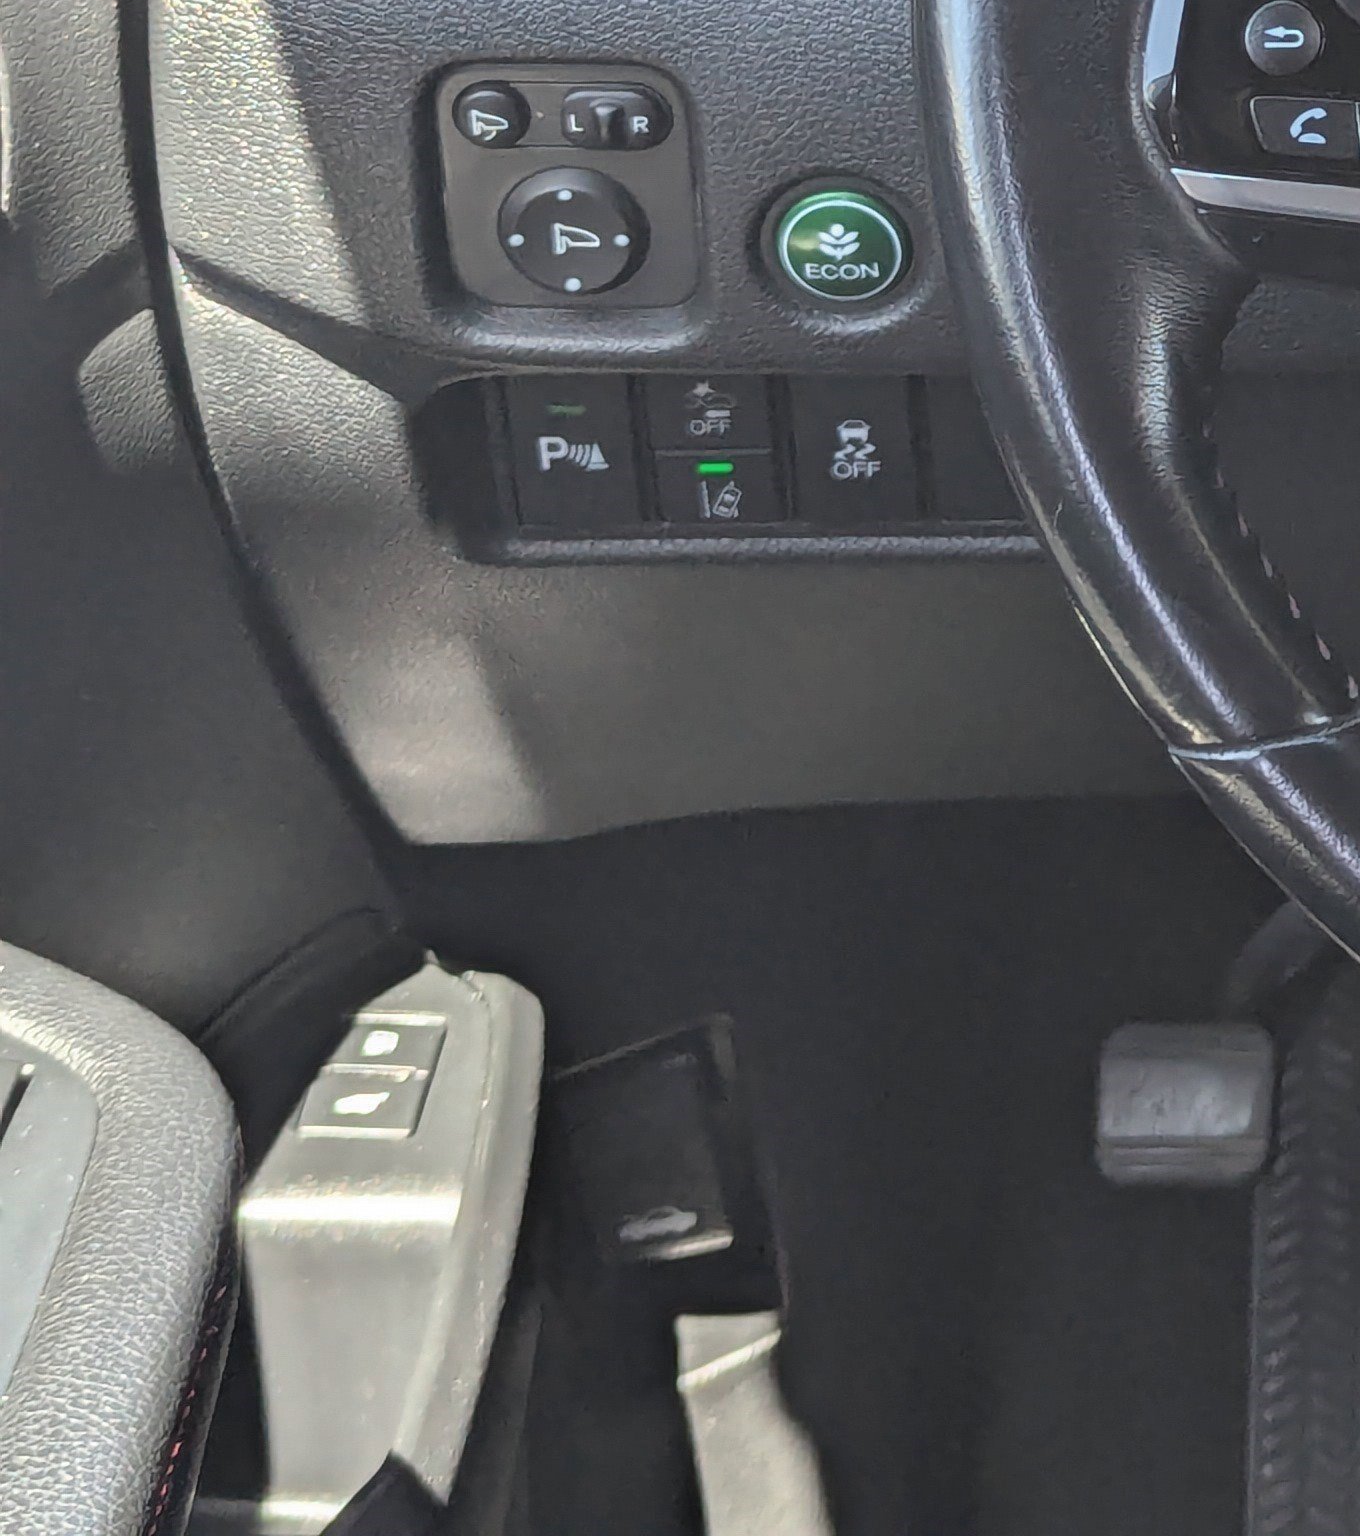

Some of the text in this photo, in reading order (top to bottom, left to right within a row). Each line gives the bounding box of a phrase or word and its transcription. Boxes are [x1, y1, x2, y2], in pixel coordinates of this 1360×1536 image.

[569, 114, 584, 132] L
[631, 116, 649, 134] R
[805, 263, 880, 280] ECON
[690, 419, 731, 435] OFF
[832, 461, 881, 479] OFF
